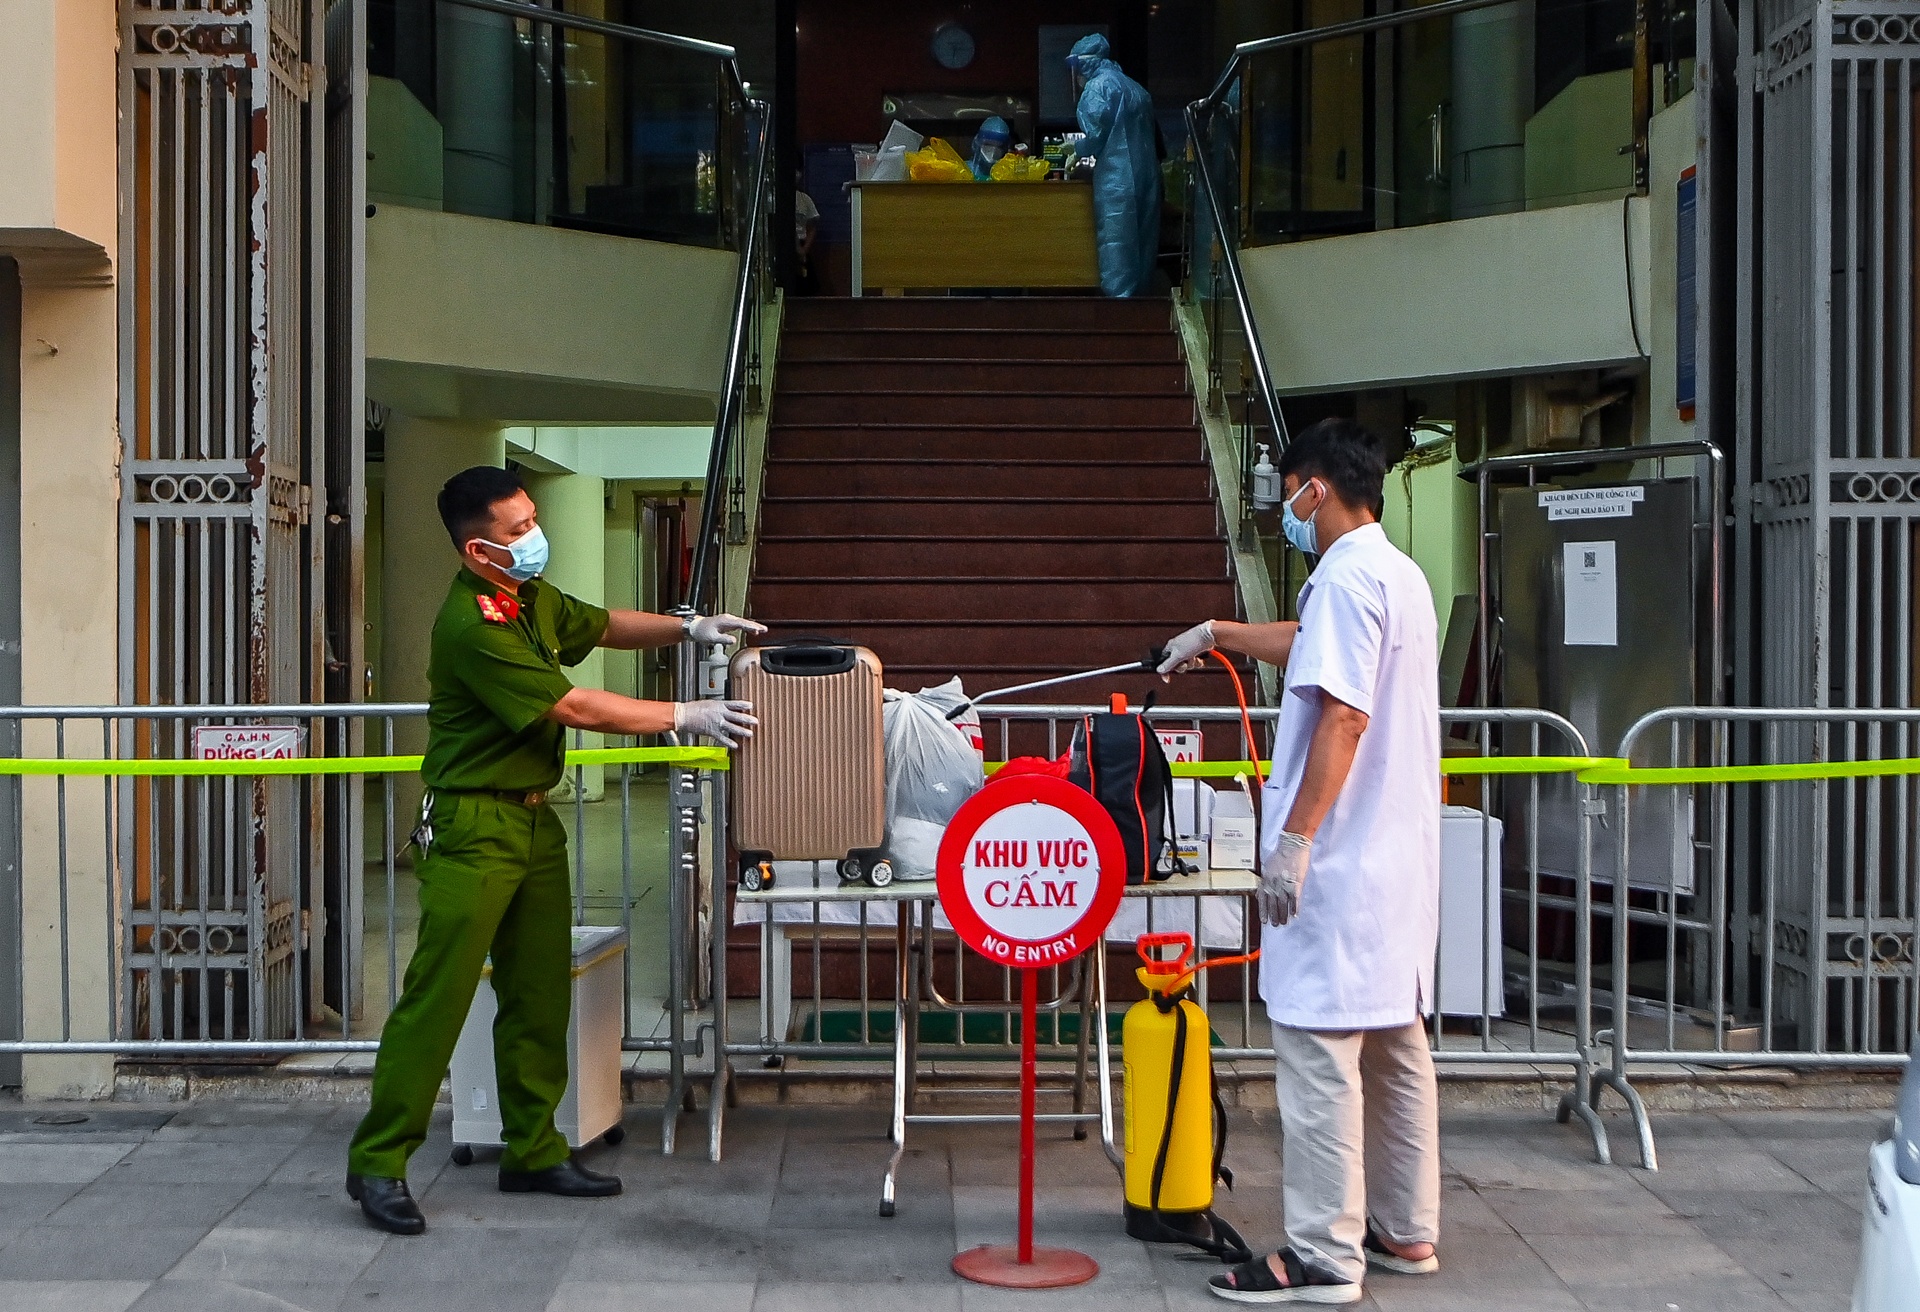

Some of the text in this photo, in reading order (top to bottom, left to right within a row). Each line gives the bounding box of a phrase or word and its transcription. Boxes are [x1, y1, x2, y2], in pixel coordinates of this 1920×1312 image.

[975, 837, 1088, 874] KHU VỰC
[984, 870, 1078, 908] CẤM
[982, 933, 1077, 961] NO ENTRY
